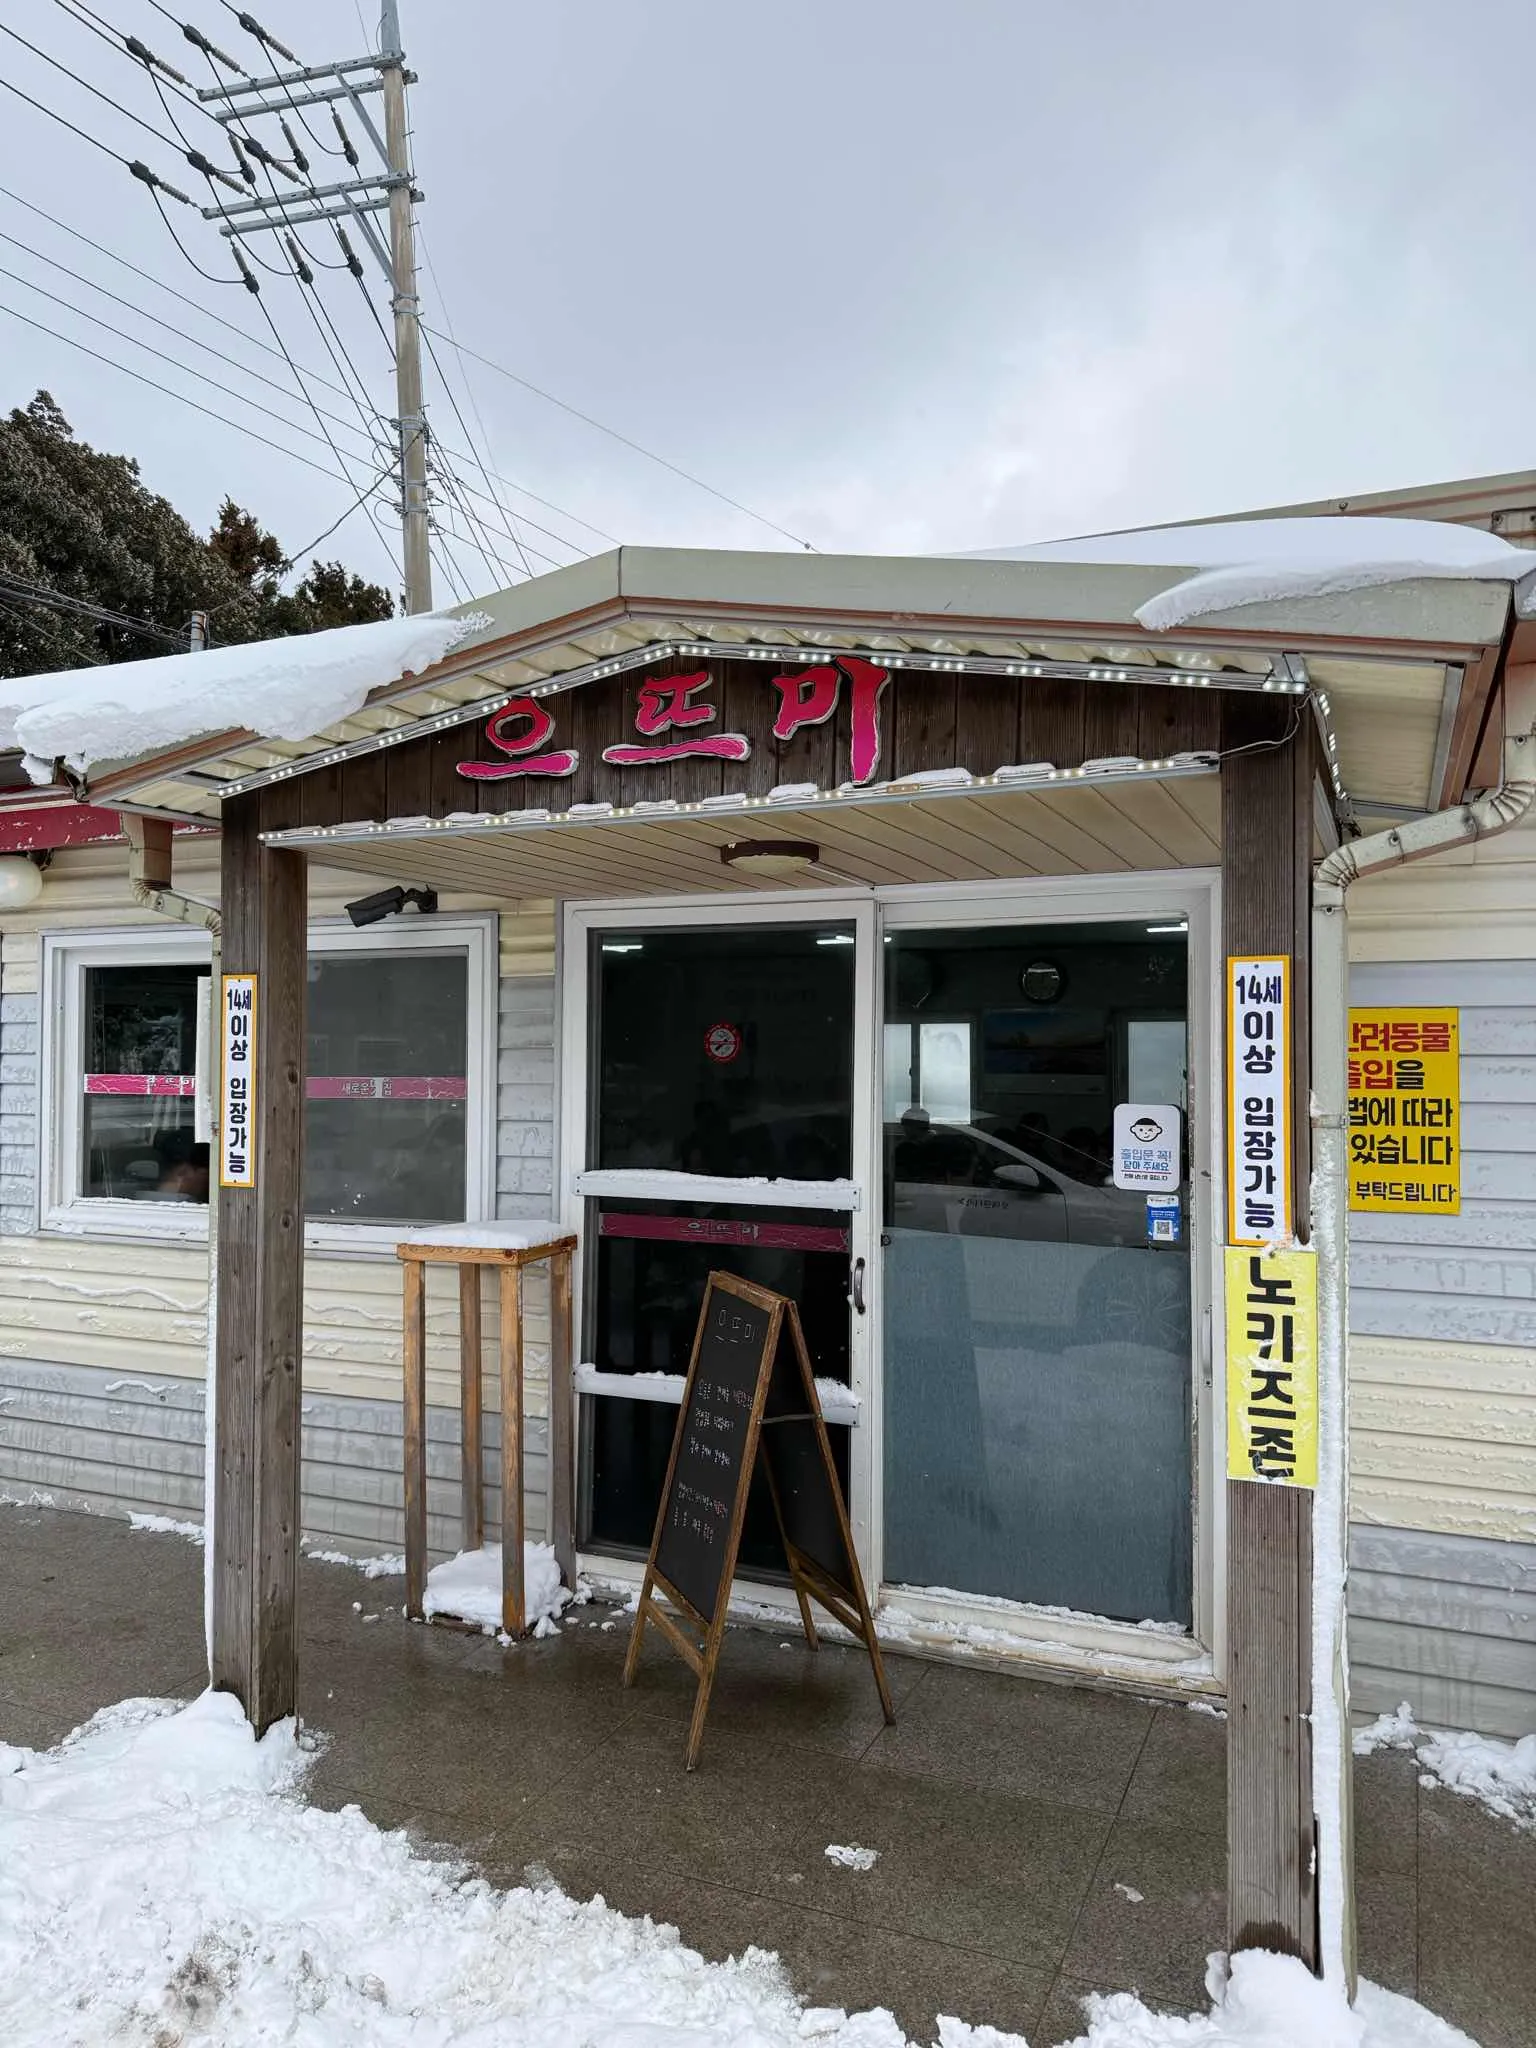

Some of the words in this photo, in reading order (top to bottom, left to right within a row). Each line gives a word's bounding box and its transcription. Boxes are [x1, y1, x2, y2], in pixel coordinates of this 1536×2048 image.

[229, 1077, 248, 1174] 입장가능
[1348, 1097, 1396, 1127] 법에
[1402, 1098, 1453, 1127] 따라
[1243, 1097, 1277, 1229] 입장가능
[1350, 1134, 1454, 1165] 있습니다
[1142, 1161, 1170, 1171] 주세요
[1355, 1181, 1456, 1202] 부탁드립니다
[1247, 1256, 1297, 1478] 노키즈존
